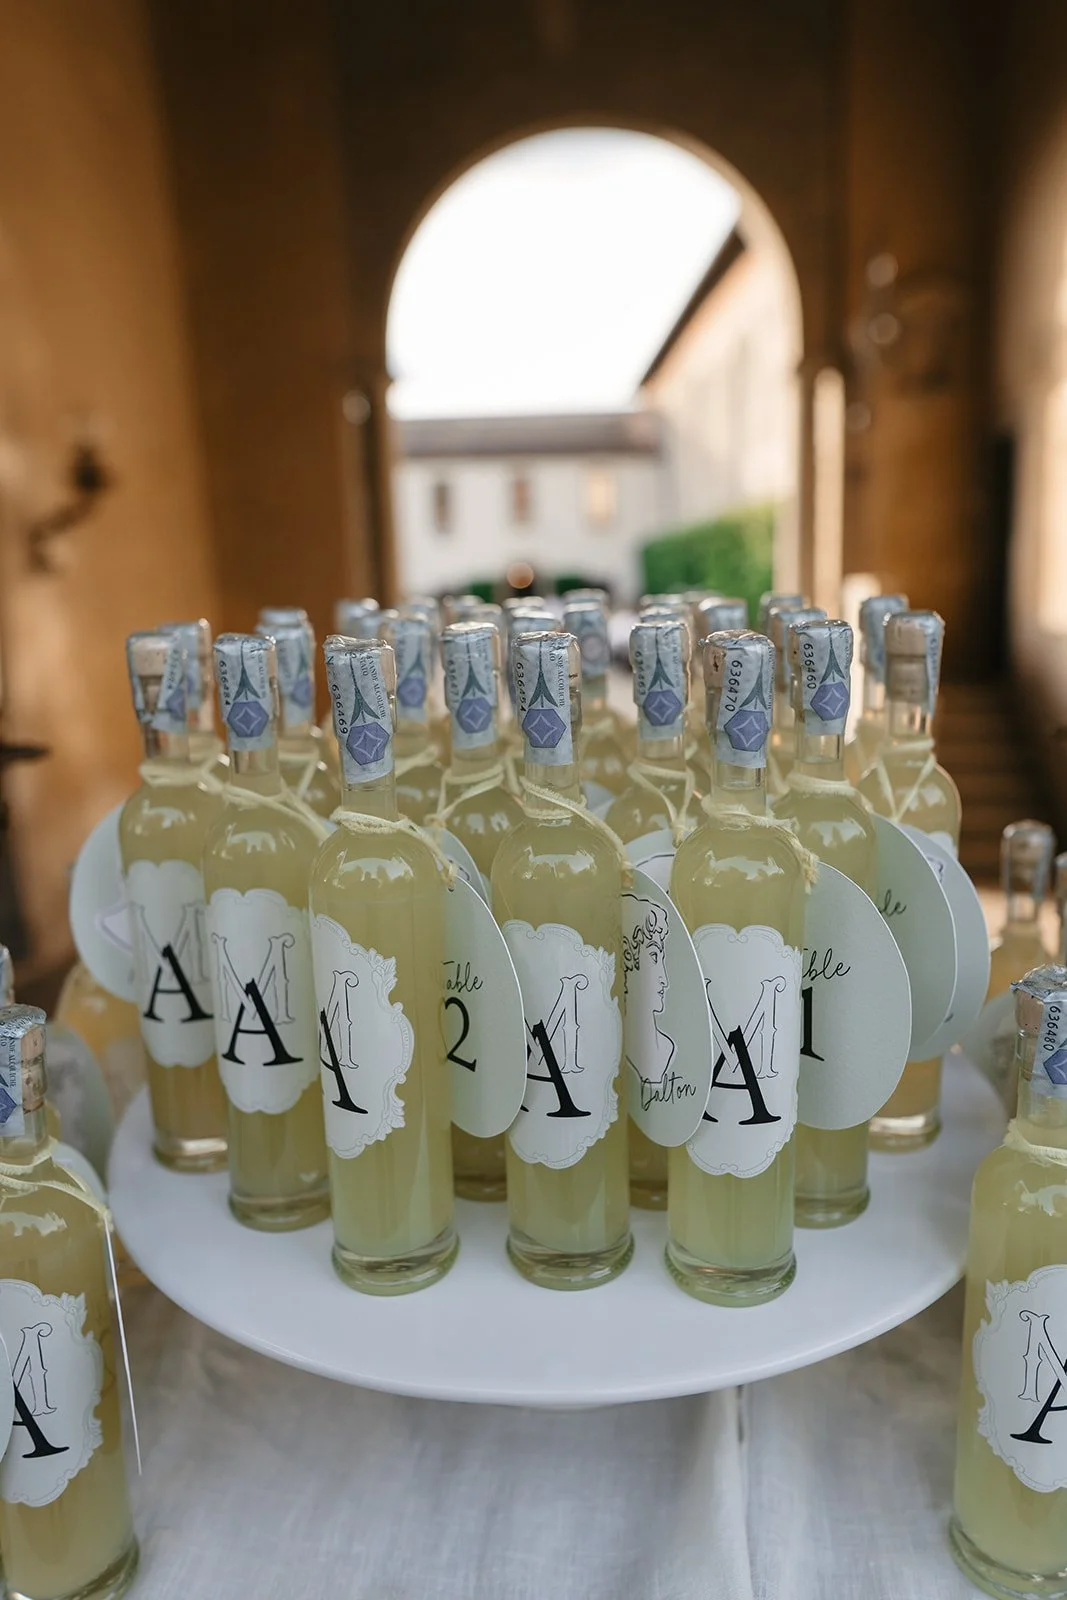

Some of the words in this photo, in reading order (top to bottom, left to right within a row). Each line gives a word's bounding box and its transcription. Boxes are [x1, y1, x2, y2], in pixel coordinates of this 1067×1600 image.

[725, 660, 743, 712] 636470
[803, 643, 817, 689] 636460
[331, 684, 348, 735] 636469
[143, 943, 214, 1023] A
[211, 932, 296, 1025] M
[802, 948, 851, 981] ble
[222, 978, 303, 1066] A
[444, 996, 477, 1072] 2
[1043, 1005, 1061, 1052] 636480
[520, 1019, 592, 1118] A
[640, 1072, 697, 1111] Dalton
[702, 1025, 782, 1126] A
